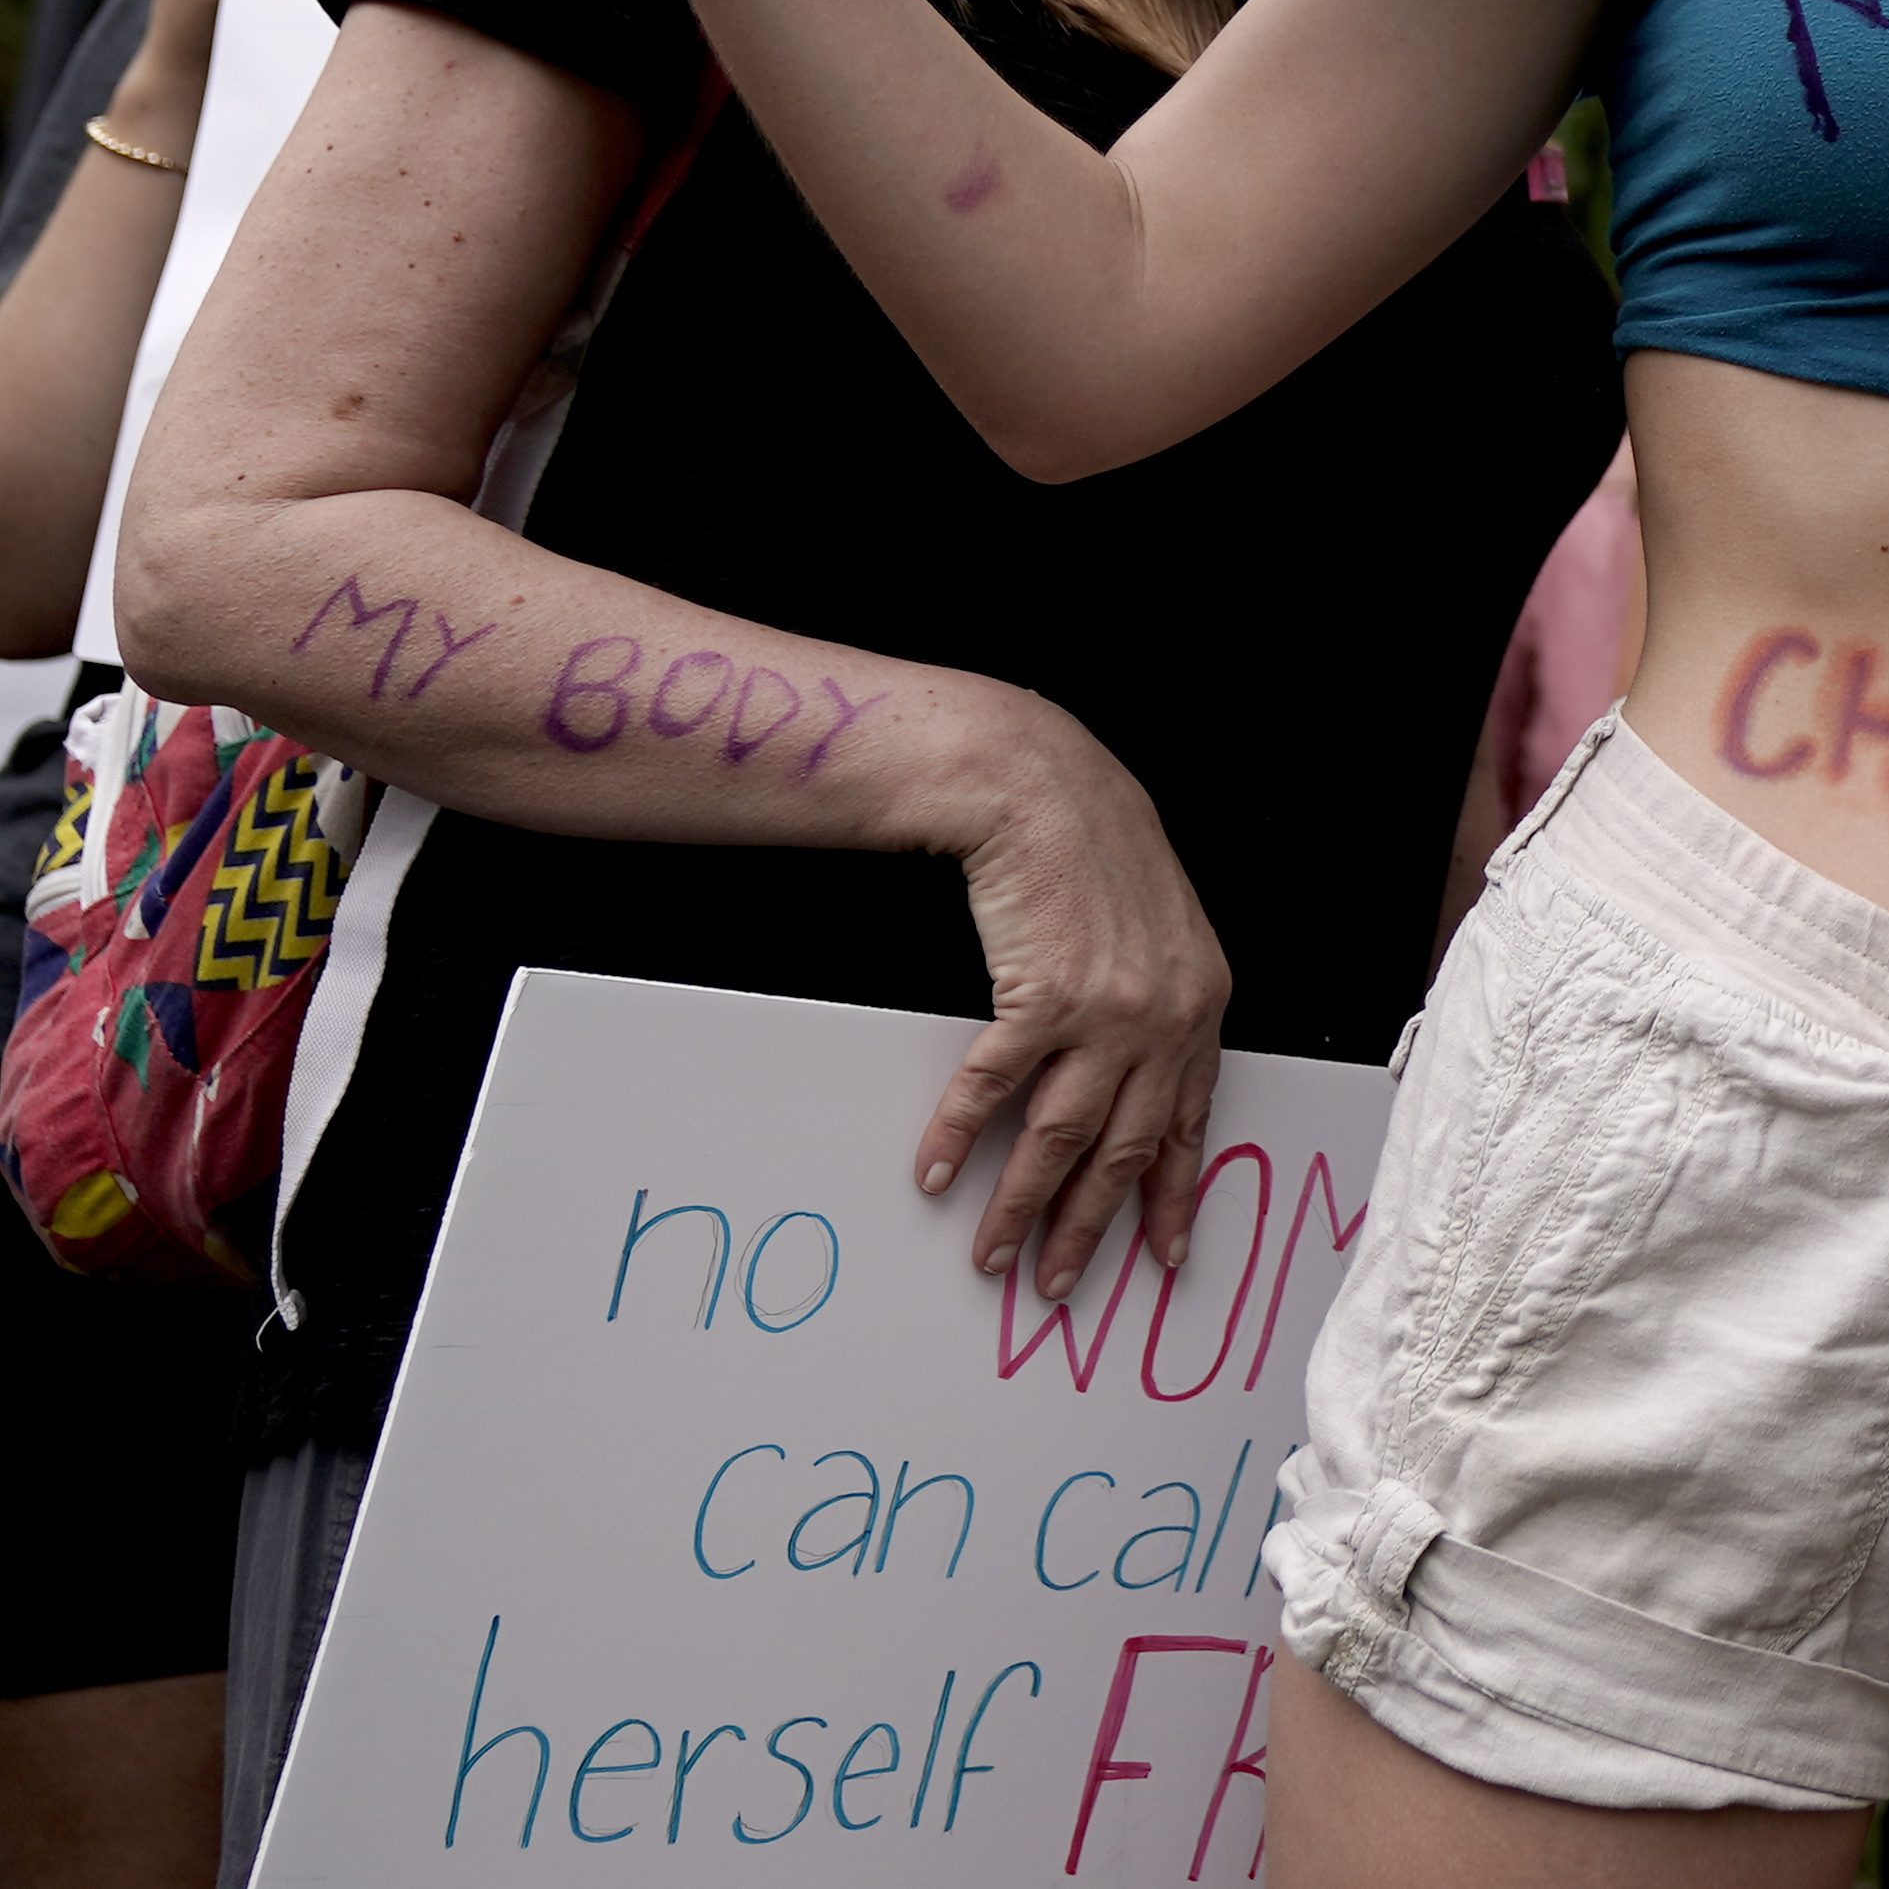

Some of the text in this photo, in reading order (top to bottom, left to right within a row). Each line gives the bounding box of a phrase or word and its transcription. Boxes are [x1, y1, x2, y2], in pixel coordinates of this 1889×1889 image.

[291, 574, 891, 781] MY BODY
[607, 1189, 840, 1333] no
[694, 1444, 975, 1580] can
[445, 1616, 1042, 1850] herself
